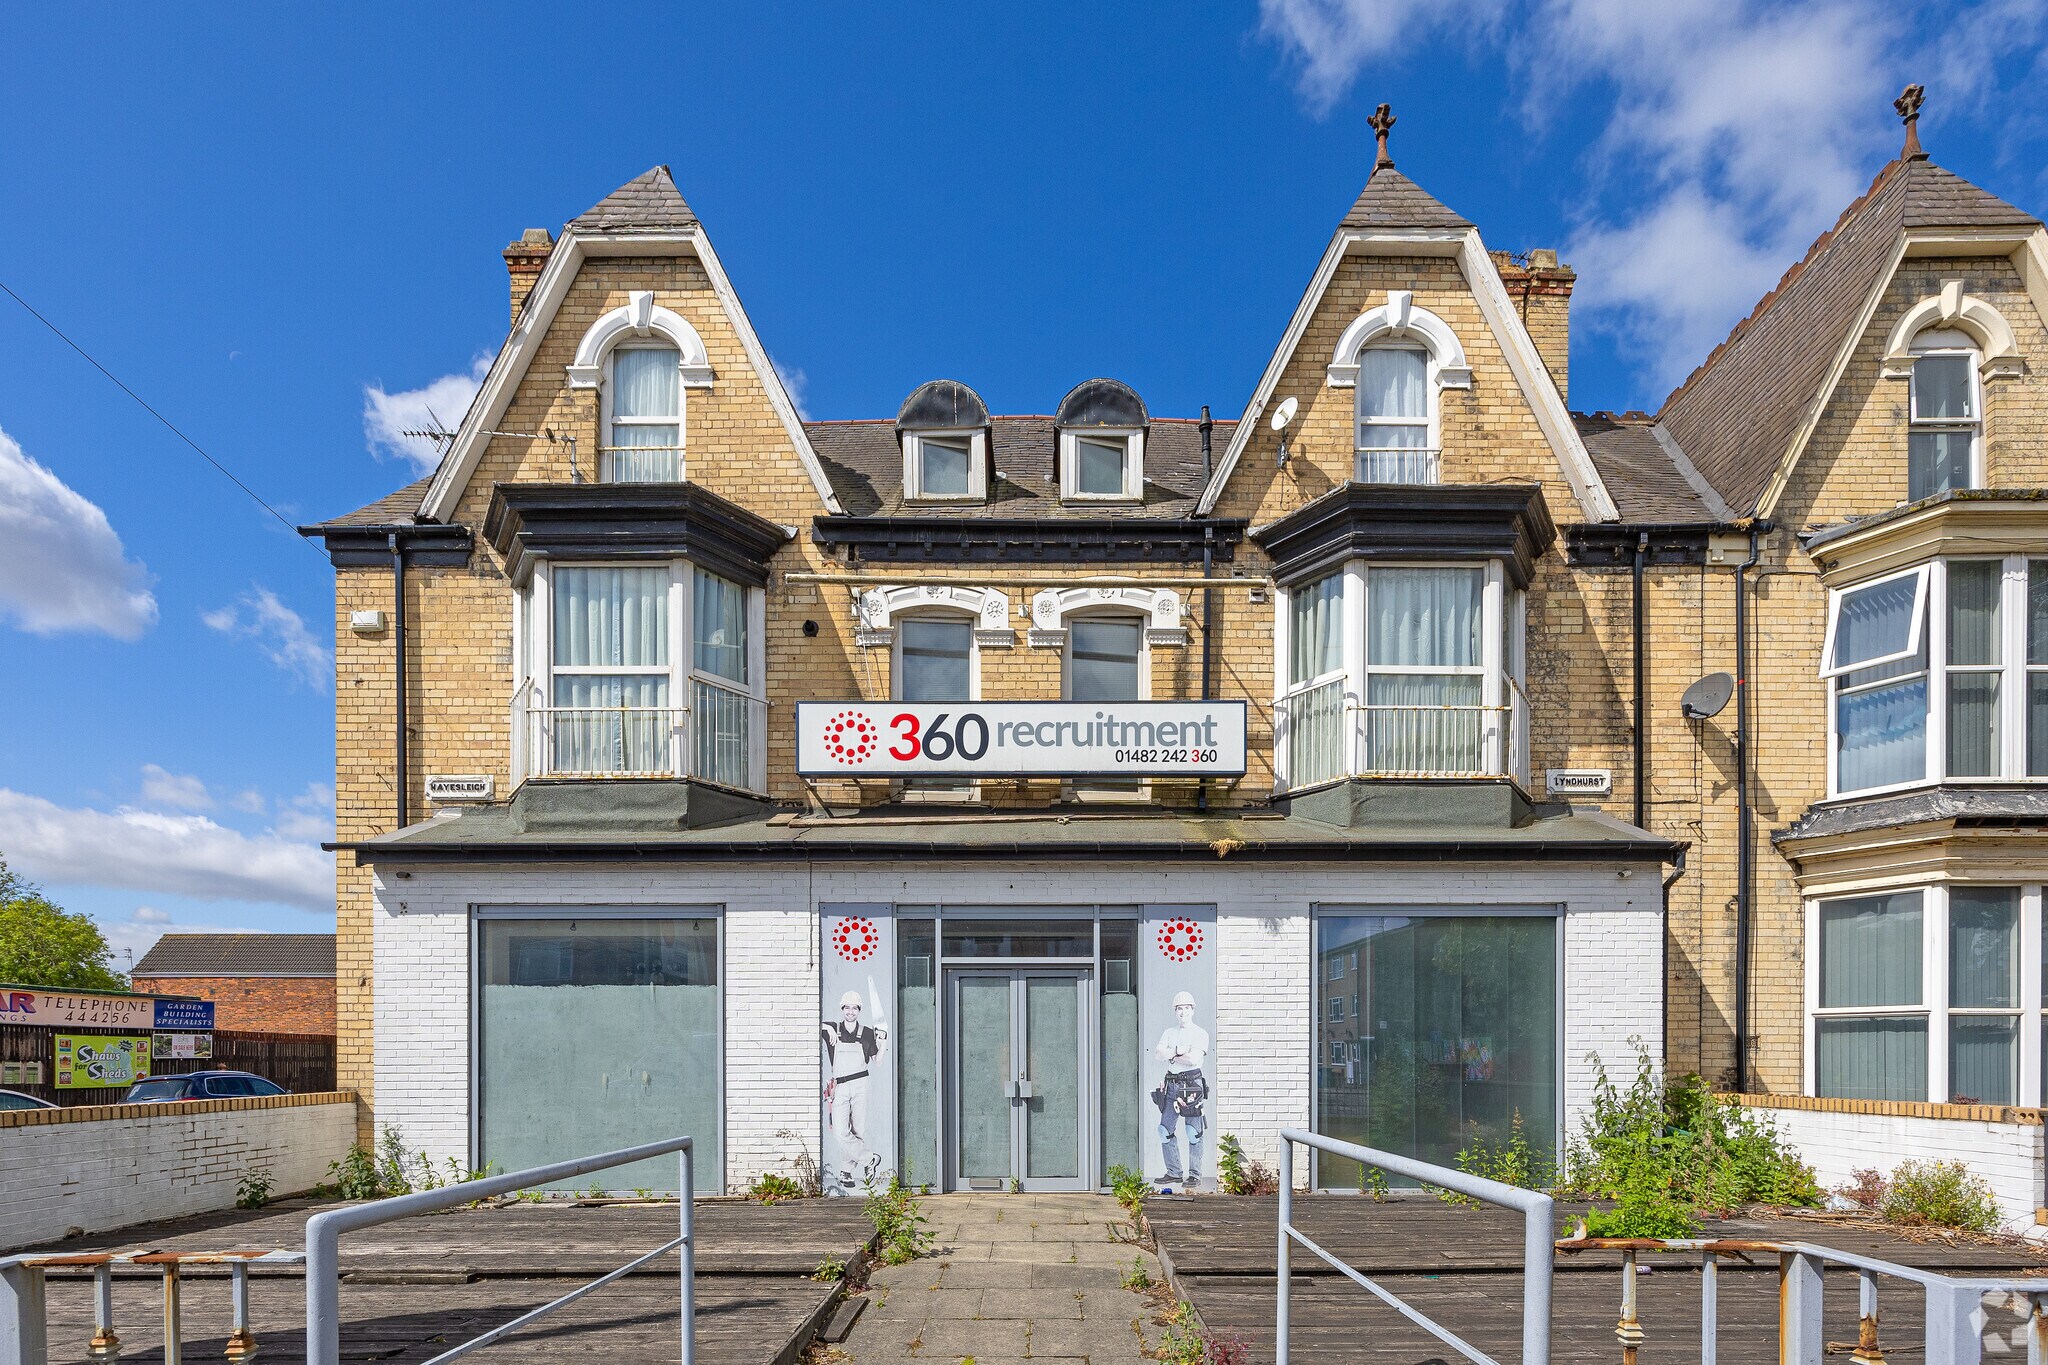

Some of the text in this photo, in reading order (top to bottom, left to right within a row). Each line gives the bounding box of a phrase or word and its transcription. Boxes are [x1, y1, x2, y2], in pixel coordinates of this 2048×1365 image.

[888, 711, 1218, 762] 360 recruitment
[1115, 749, 1218, 763] 01482 242 360
[1554, 777, 1606, 787] LYNDHURST
[44, 996, 148, 1012] TELEPHONE
[167, 1003, 204, 1011] GARDEN
[64, 1010, 130, 1024] 444256
[156, 1018, 213, 1026] SPECIALISTS
[78, 1045, 121, 1063] Shaws
[75, 1062, 87, 1071] for
[88, 1062, 127, 1080] Sheds
